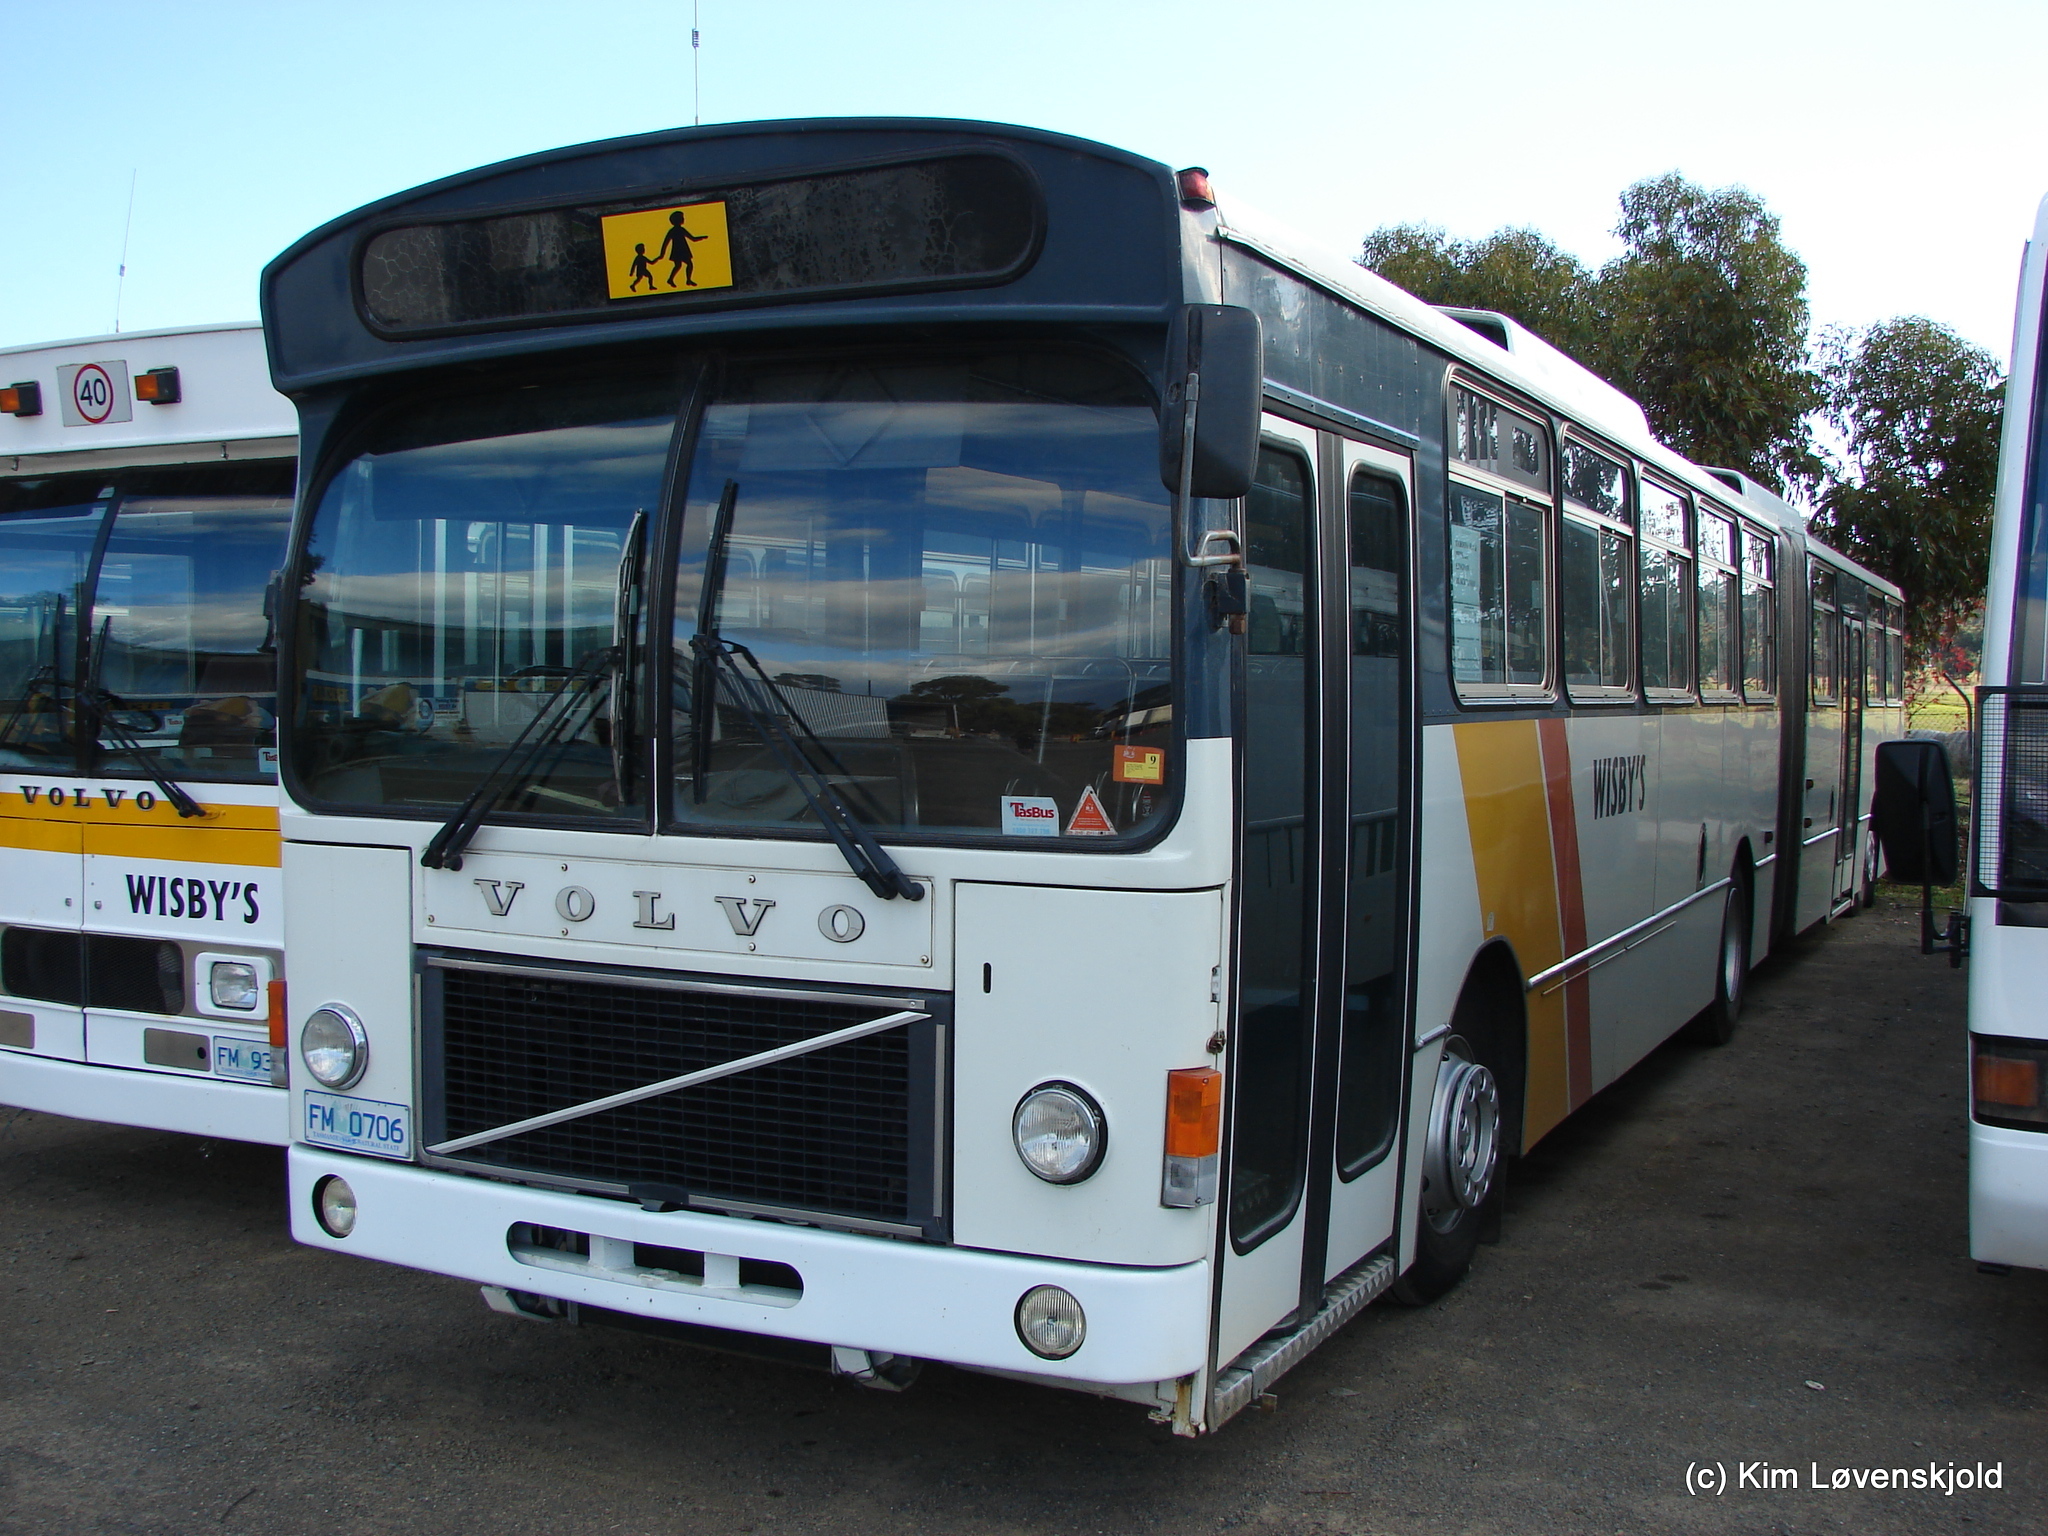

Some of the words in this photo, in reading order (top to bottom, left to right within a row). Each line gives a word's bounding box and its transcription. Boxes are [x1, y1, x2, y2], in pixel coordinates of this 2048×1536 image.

[80, 378, 107, 406] 40
[20, 785, 156, 810] VOLVO
[1593, 754, 1646, 820] WISBY'S
[1009, 802, 1055, 819] TasBus
[125, 874, 260, 924] WISBY'S
[473, 878, 866, 944] VOLVO
[217, 1046, 239, 1068] FM
[309, 1103, 334, 1133] FM
[349, 1110, 404, 1144] 0706
[383, 1144, 401, 1152] STATE
